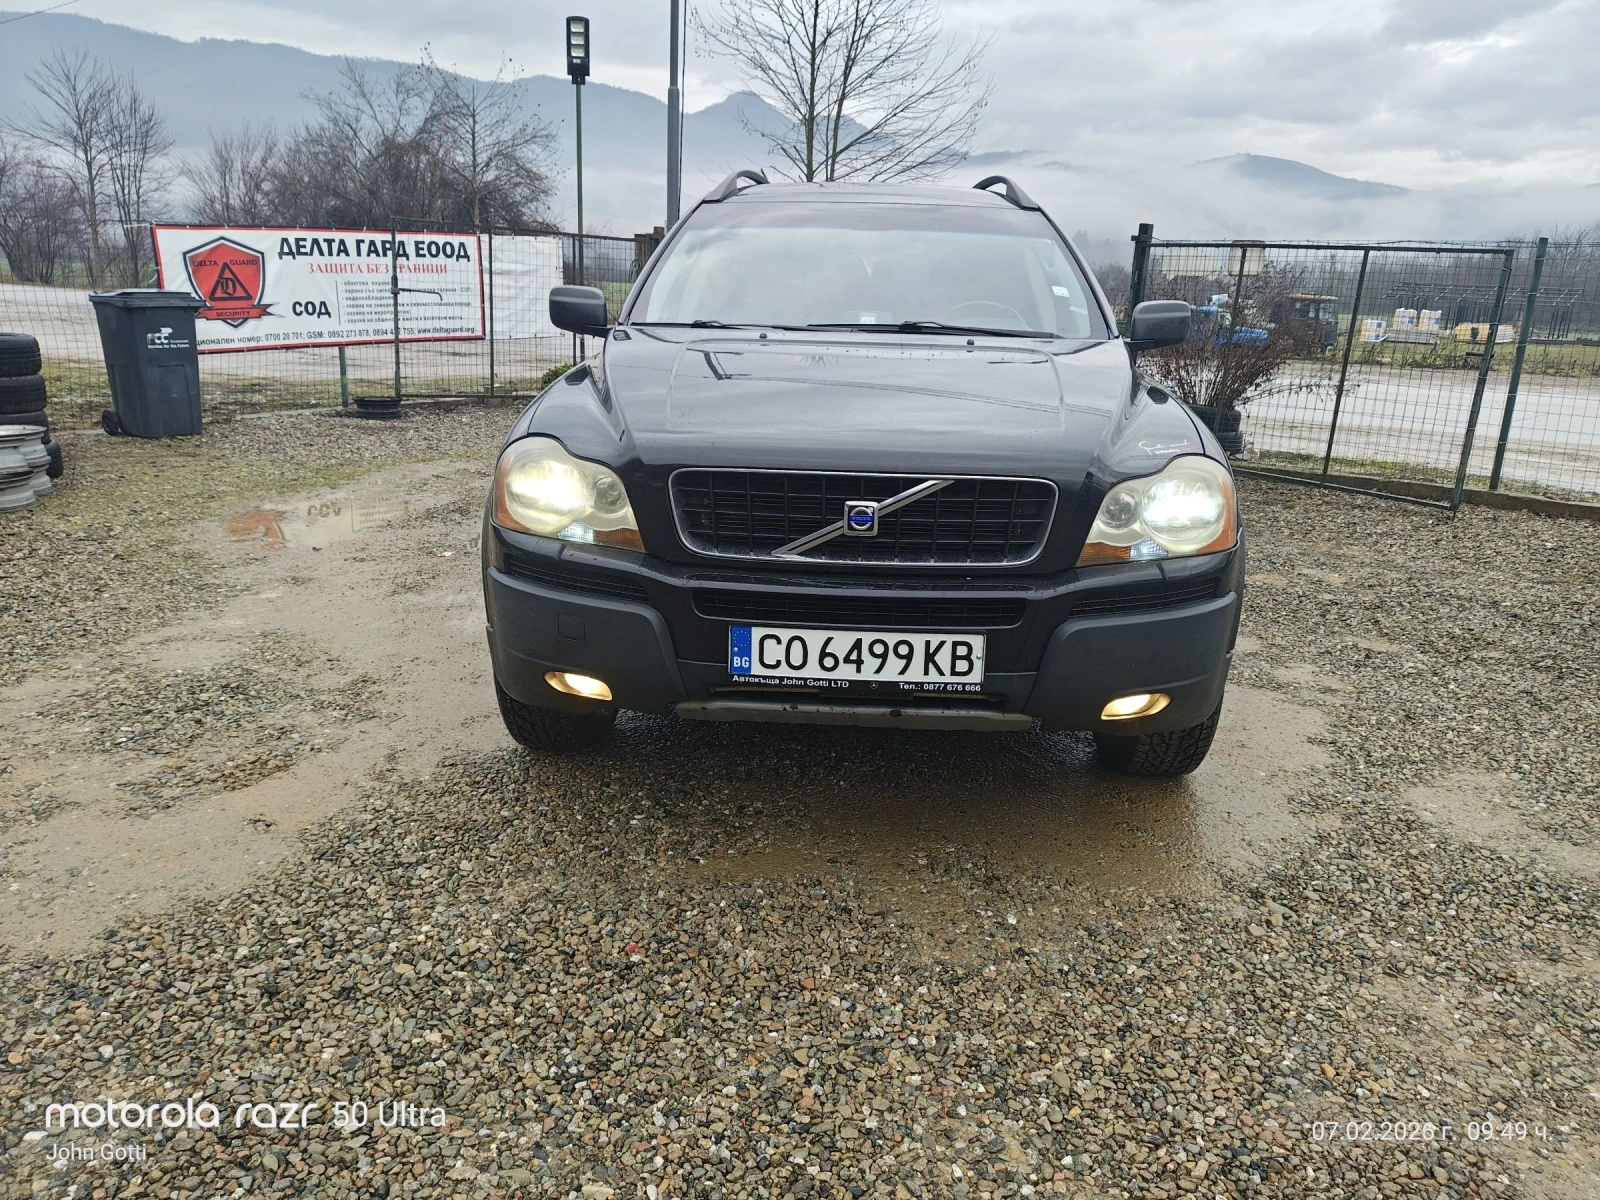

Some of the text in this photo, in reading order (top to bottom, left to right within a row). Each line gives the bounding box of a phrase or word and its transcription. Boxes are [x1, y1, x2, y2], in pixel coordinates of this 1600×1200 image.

[278, 237, 471, 262] ДЕЛТА ГАРД ЕООД
[307, 262, 448, 275] ЗАЩИТА БЕЗ РАНИЦИ
[292, 301, 332, 319] СОД
[196, 338, 235, 346] ционален
[237, 336, 263, 344] номер:
[264, 333, 280, 341] 0700
[306, 330, 326, 339] GSM:
[327, 330, 345, 338] 0892
[346, 329, 357, 337] 273
[373, 328, 388, 336] 0894
[417, 326, 475, 335] www.deltaguard.org
[733, 656, 750, 668] BG
[732, 674, 849, 688] Автокъща John Gotti LTD
[899, 682, 921, 690] Тел.:
[923, 683, 945, 691] 0877
[965, 684, 981, 692] 666
